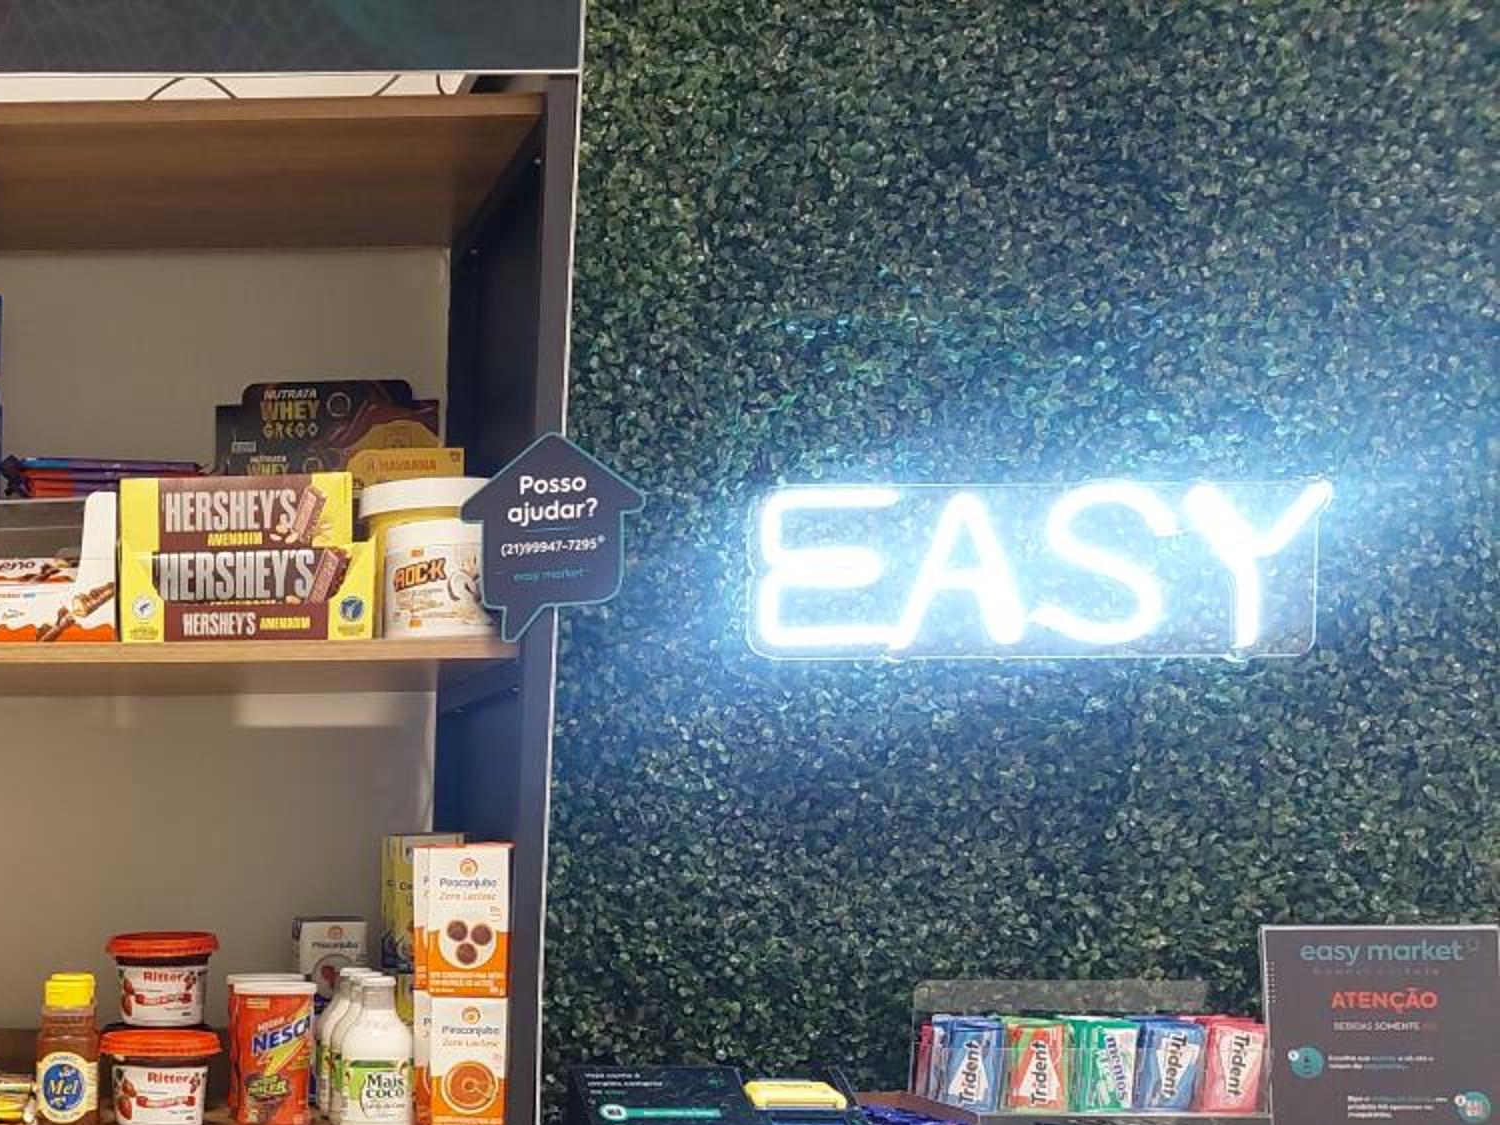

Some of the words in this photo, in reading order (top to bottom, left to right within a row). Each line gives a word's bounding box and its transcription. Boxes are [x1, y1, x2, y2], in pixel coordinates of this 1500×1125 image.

[260, 399, 321, 423] WHEY
[519, 475, 588, 495] Posso
[164, 489, 300, 534] HERSHEY'S
[507, 497, 599, 527] ajudar?
[158, 550, 316, 602] HERSHEY'S
[393, 558, 447, 592] ROCK
[758, 483, 1334, 652] EASY
[182, 612, 257, 637] HERSHEY'S
[1300, 943, 1363, 965] easy
[1367, 938, 1464, 961] market
[142, 970, 184, 982] Ritter
[1330, 987, 1438, 1012] ATENÇÃO
[958, 1040, 982, 1105] Trident
[1030, 1041, 1048, 1105] Trident
[1106, 1034, 1132, 1102] mentos
[1160, 1031, 1188, 1099] Trident
[1227, 1034, 1251, 1096] Trident
[46, 1079, 79, 1102] Mel
[146, 1077, 189, 1091] Ritter
[366, 1072, 405, 1088] Mais
[366, 1088, 404, 1099] coco
